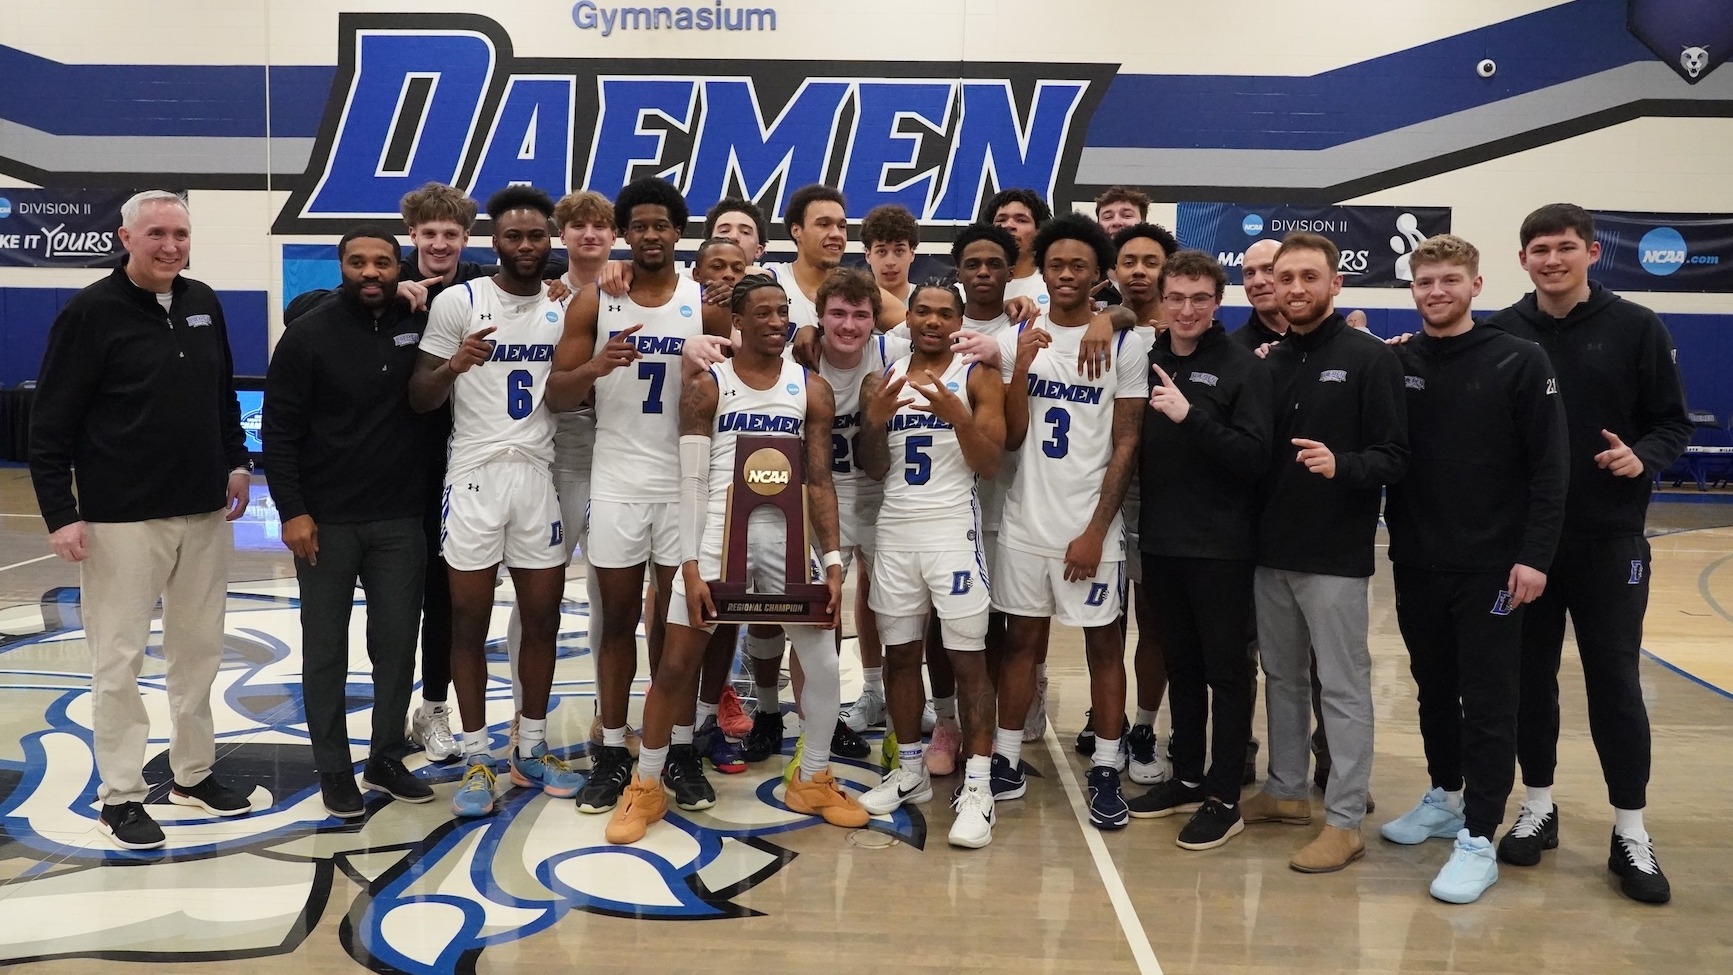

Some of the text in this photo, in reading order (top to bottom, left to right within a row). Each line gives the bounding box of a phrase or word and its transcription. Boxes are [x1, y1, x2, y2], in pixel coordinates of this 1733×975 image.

[572, 0, 777, 36] Gymnasium
[298, 29, 1091, 223] DAEMEN
[20, 202, 91, 215] DIVISION II
[1244, 223, 1263, 231] NCAA
[1271, 219, 1347, 232] DIVISION II
[0, 223, 113, 258] KE IT YOURS
[1217, 251, 1244, 267] MA
[507, 369, 533, 420] 6
[638, 361, 666, 414] 7
[1042, 406, 1071, 459] 3
[904, 435, 933, 485] 5
[747, 470, 789, 485] NCAA
[949, 570, 974, 596] D
[1083, 582, 1109, 607] D
[727, 602, 804, 613] REGIONAL CHAMPION
